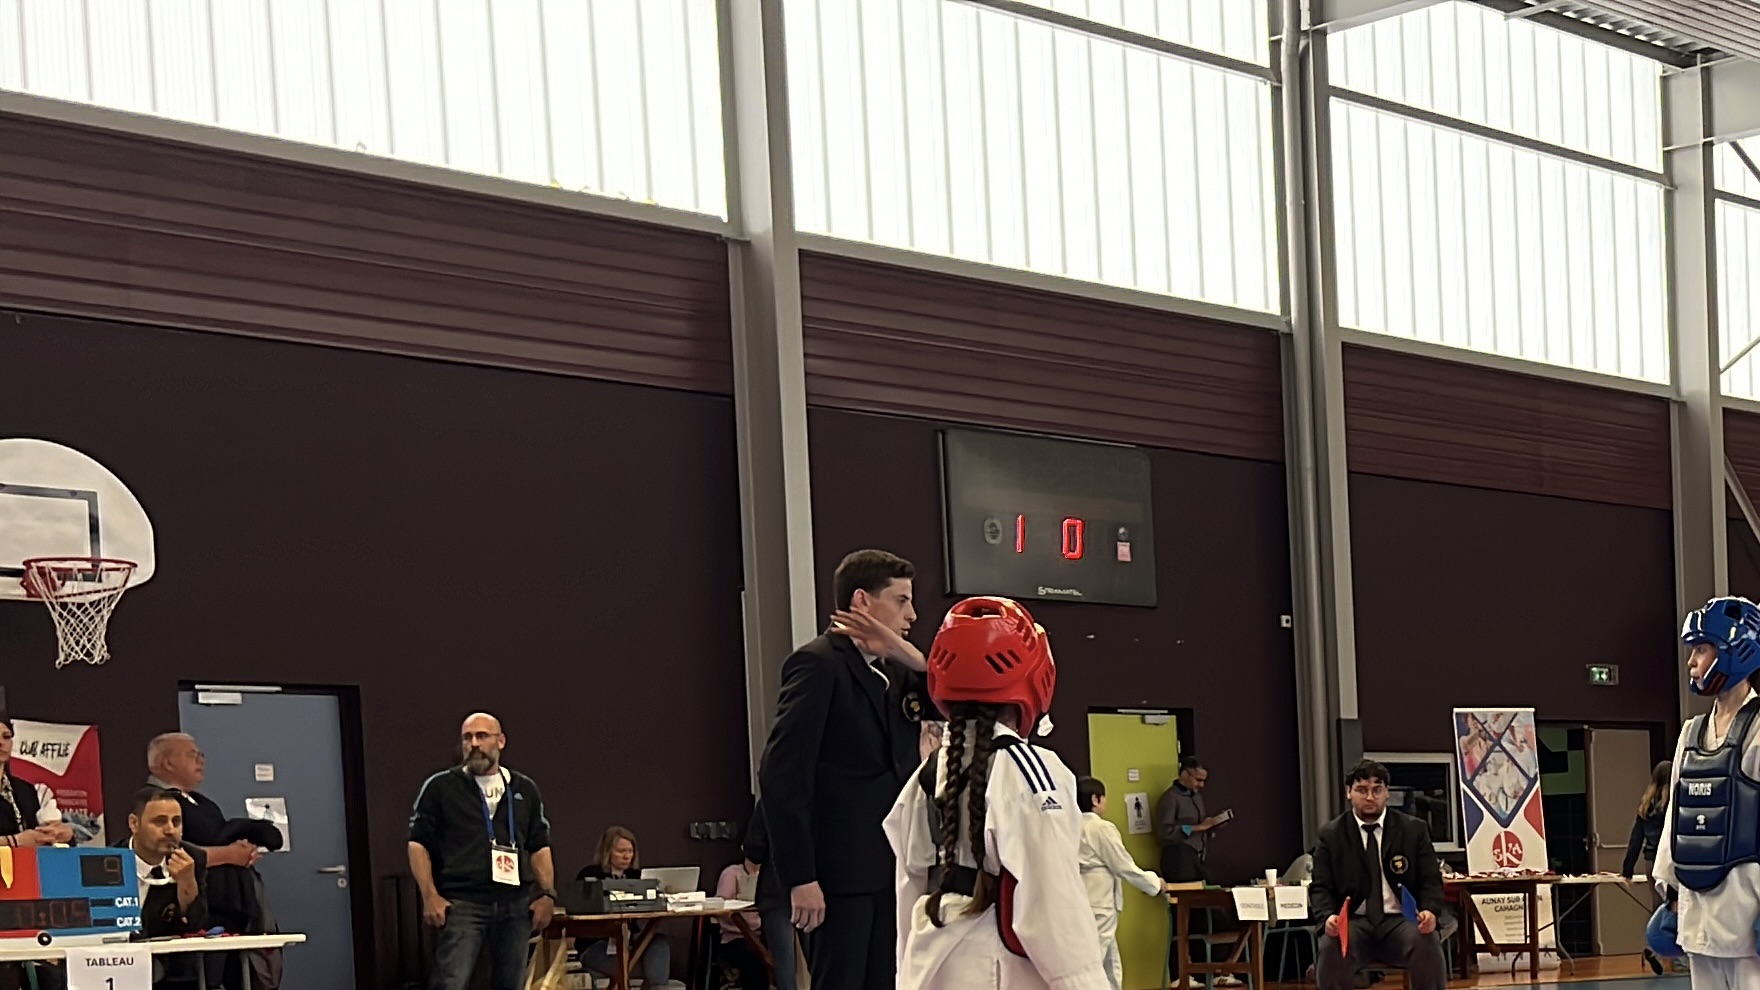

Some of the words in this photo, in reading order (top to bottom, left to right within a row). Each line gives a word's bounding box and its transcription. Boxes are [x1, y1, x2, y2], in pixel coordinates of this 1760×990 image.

[1017, 515, 1025, 553] 1
[1062, 518, 1084, 560] 0
[1689, 783, 1712, 795] NORIS
[115, 897, 138, 907] CAT.1
[117, 917, 141, 927] CAT.2
[85, 957, 134, 967] TABLEAU
